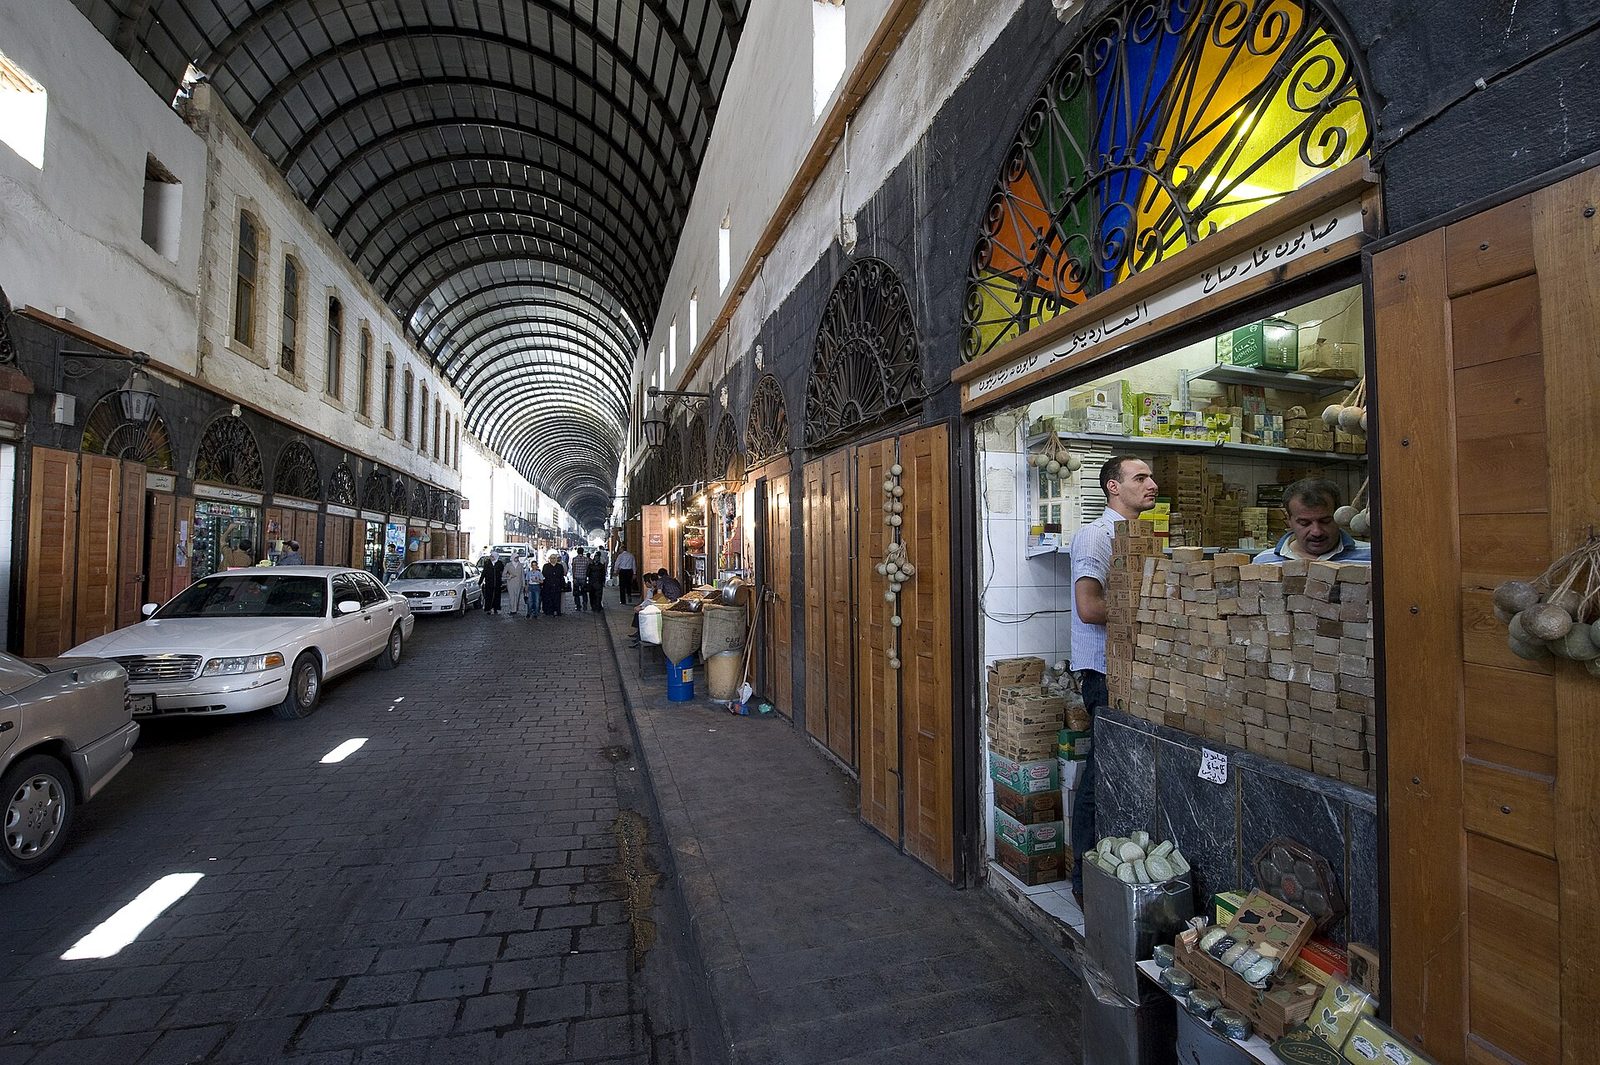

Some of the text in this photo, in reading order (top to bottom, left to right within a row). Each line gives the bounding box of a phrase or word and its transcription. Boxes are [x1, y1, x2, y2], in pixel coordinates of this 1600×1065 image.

[1200, 217, 1339, 294] صابون غار صاغ
[1048, 300, 1149, 363] المارديني
[1016, 355, 1038, 374] صابون
